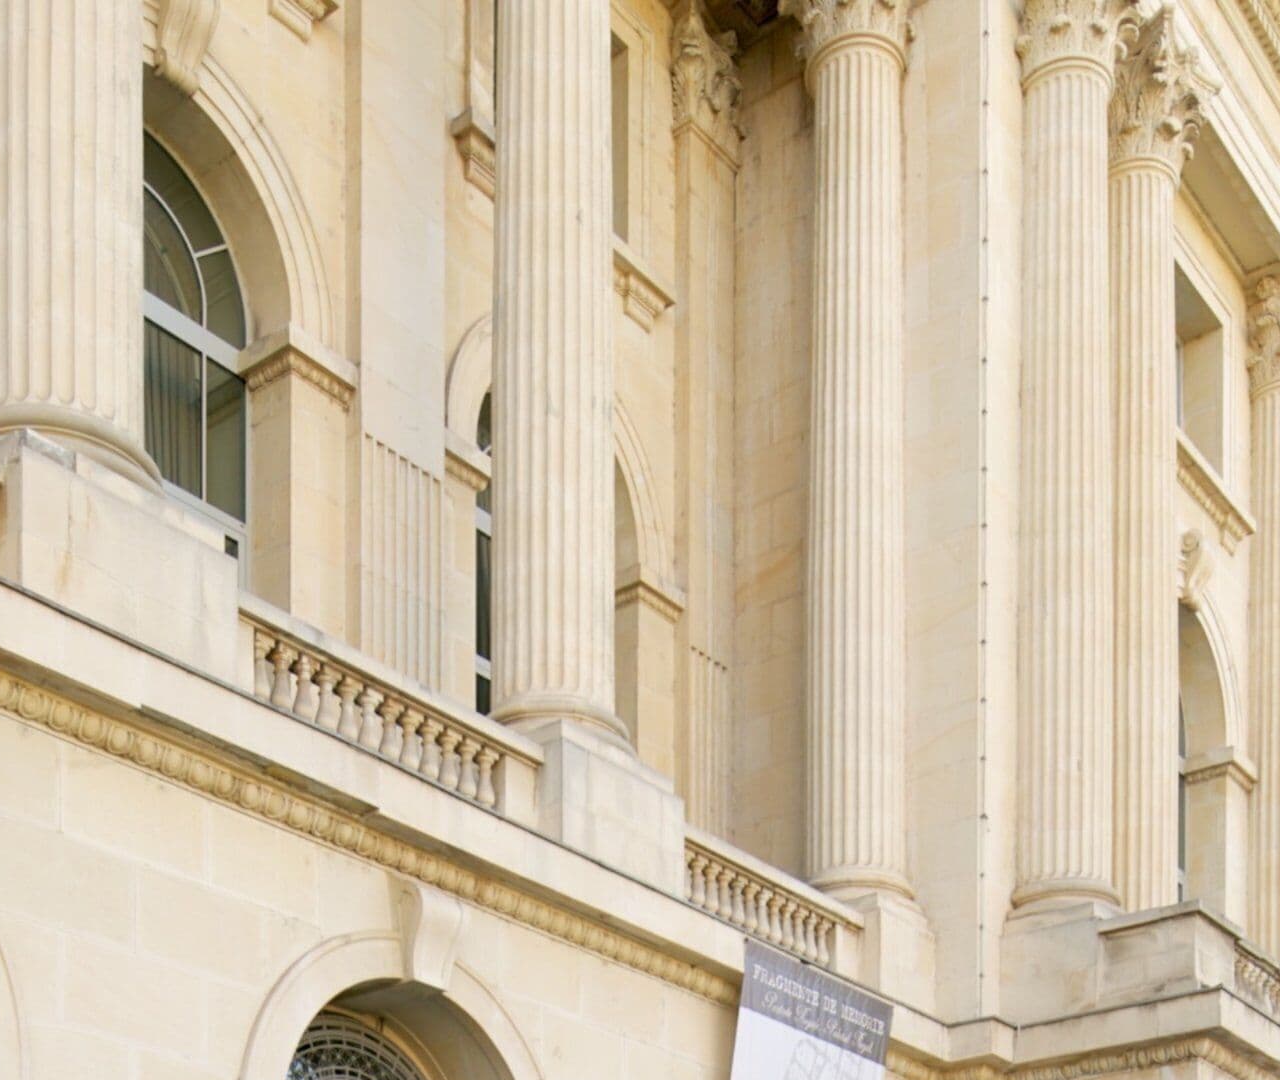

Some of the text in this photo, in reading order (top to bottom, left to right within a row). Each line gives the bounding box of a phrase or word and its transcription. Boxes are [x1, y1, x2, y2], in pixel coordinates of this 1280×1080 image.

[753, 963, 820, 1007] FRAGMENTE
[823, 994, 838, 1015] DE
[841, 1002, 885, 1035] MEMORIE
